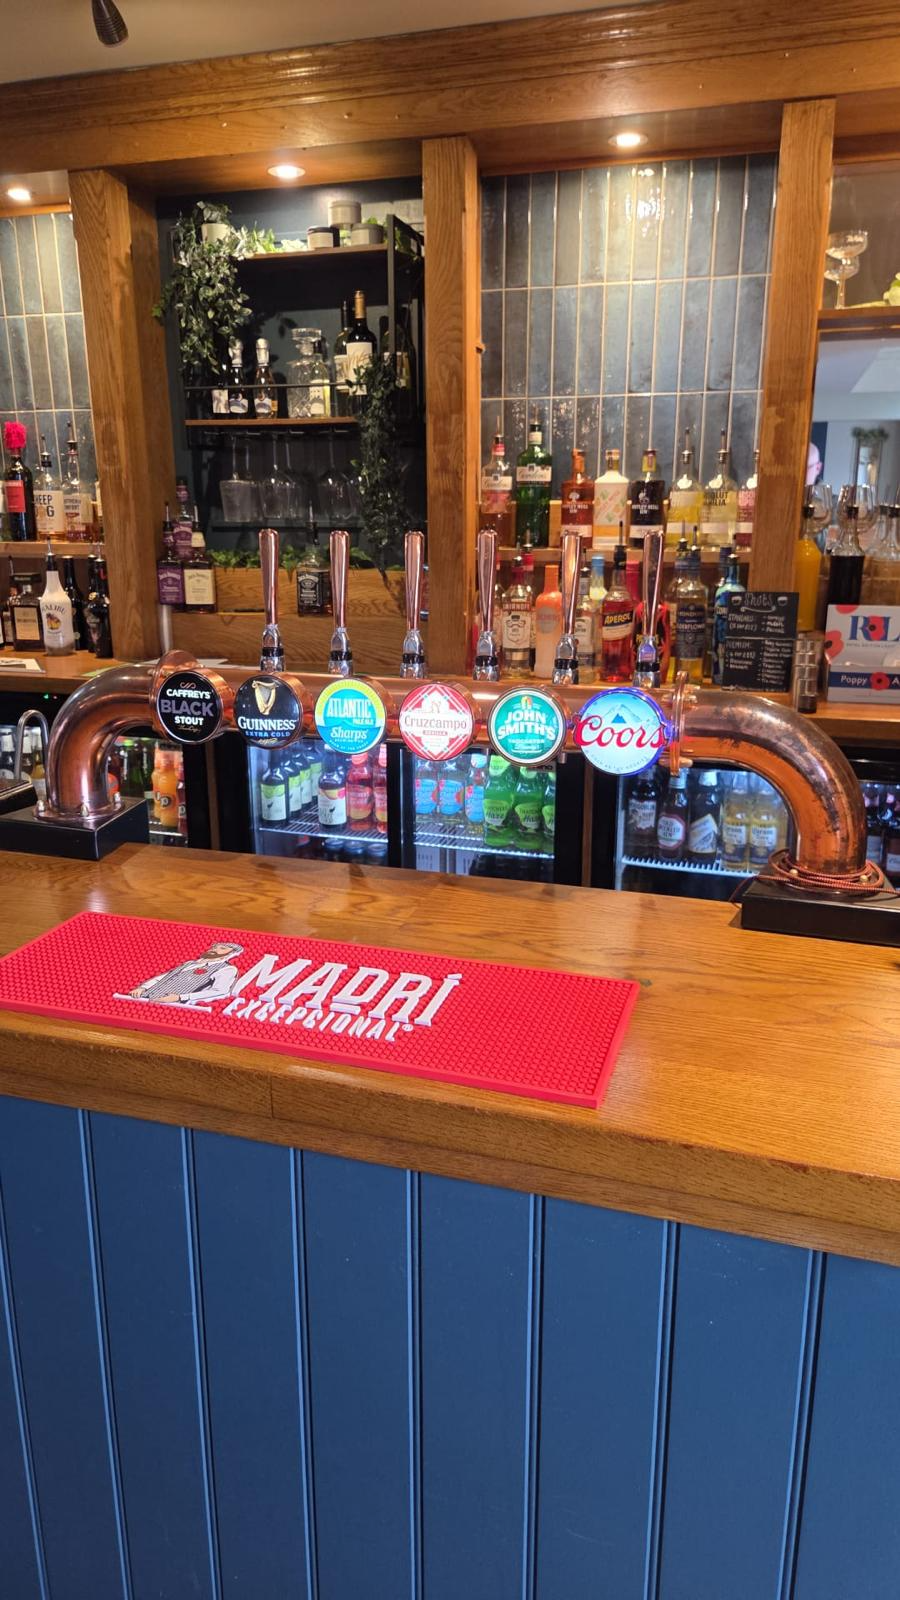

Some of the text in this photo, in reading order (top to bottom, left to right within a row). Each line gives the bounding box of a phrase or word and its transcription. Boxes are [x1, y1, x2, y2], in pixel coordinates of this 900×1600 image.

[744, 592, 774, 607] Shots
[42, 603, 66, 615] MALIBU
[604, 612, 631, 625] APEROL
[841, 674, 868, 685] Poppy
[166, 688, 211, 699] CAFFREY'S
[160, 699, 214, 717] BLACK
[326, 697, 372, 718] ATLANTIC
[174, 715, 204, 726] STOUT
[237, 716, 296, 731] GUINNESS
[404, 715, 467, 731] Cruzcampo
[504, 709, 546, 724] JOHN
[497, 721, 556, 741] SMITH'S
[573, 714, 667, 748] Coors
[230, 953, 463, 1027] MADRÍ
